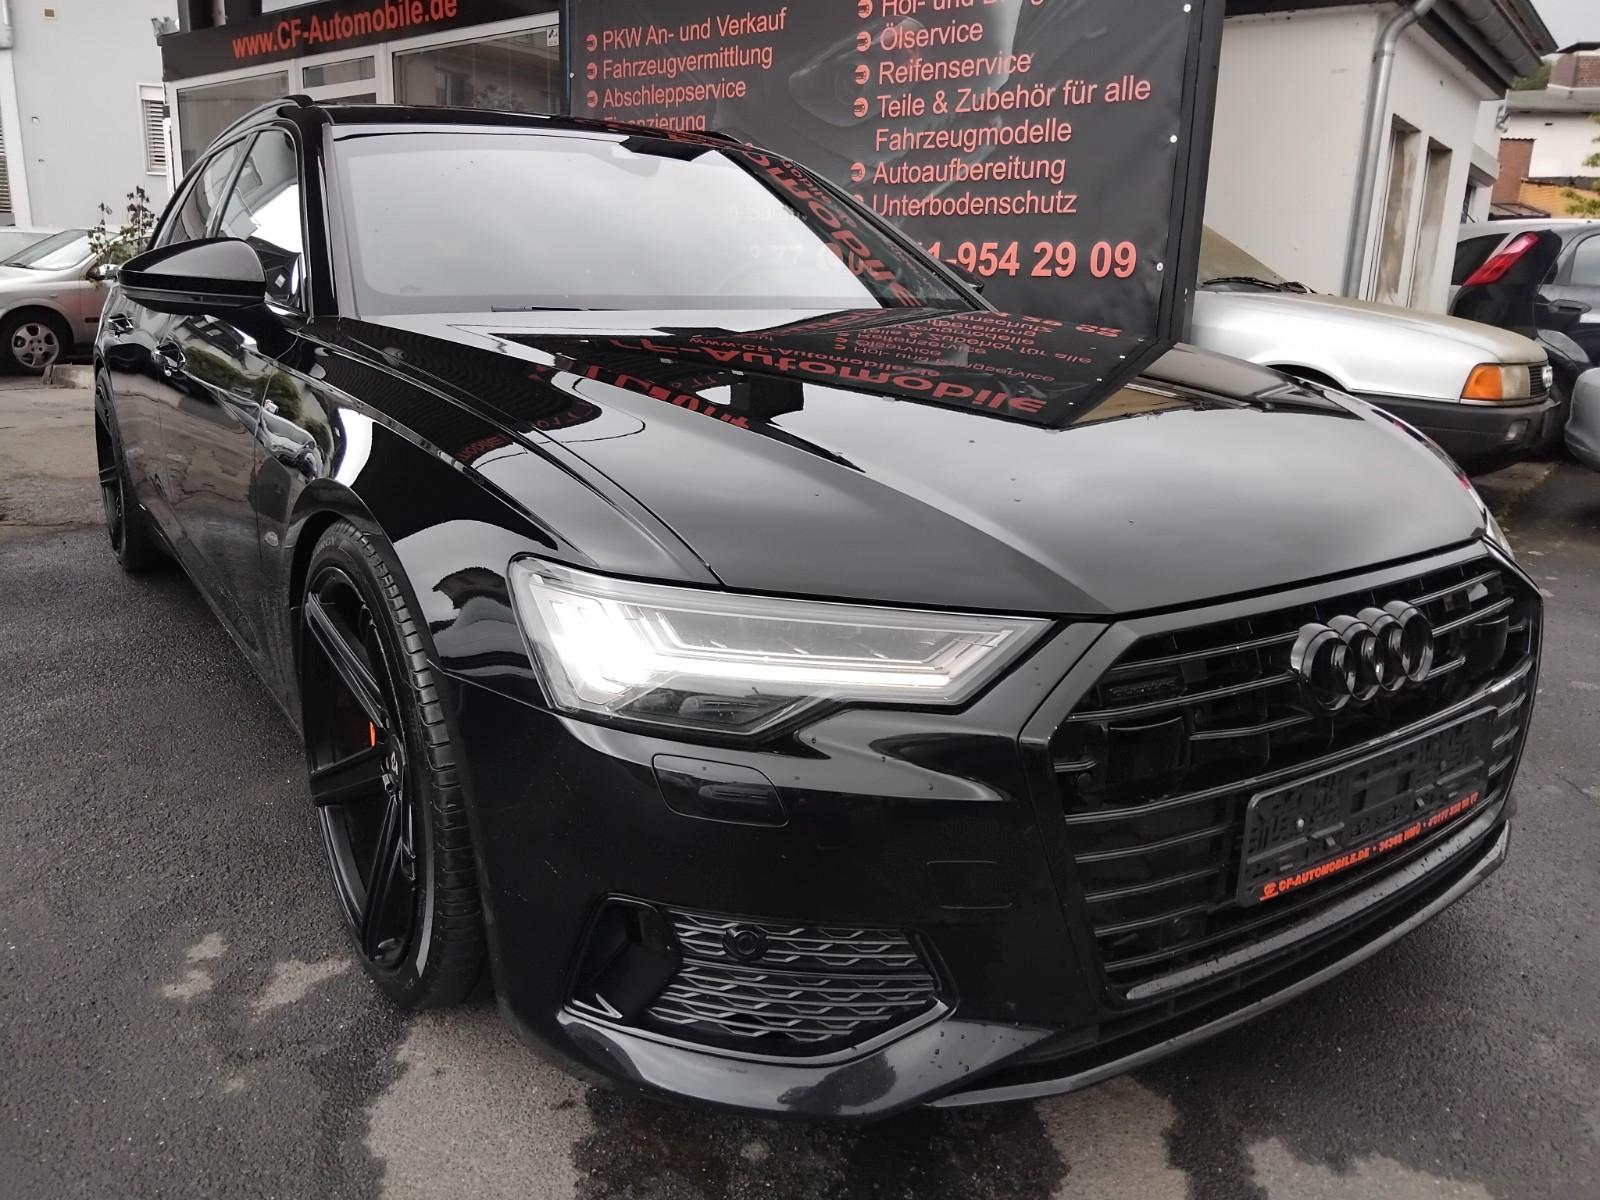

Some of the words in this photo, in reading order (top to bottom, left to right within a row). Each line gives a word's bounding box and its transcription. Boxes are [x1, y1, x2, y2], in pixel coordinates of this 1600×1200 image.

[232, 0, 457, 59] www.CF-Automobile.de
[603, 28, 641, 50] PKW
[646, 25, 674, 46] An-
[680, 20, 711, 42] und
[716, 7, 787, 37] Verkauf
[880, 20, 983, 51] Ölservice
[603, 45, 773, 80] Fahrzeugvermittlung
[878, 52, 1031, 85] Reifenservice
[603, 77, 746, 109] Abschleppservice
[877, 91, 924, 119] Teile
[933, 90, 948, 114] &
[955, 84, 1055, 113] Zubehör
[1063, 79, 1097, 105] für
[1105, 75, 1151, 102] alle
[875, 118, 1072, 153] Fahrzeugmodelle
[872, 156, 1066, 185] Autoaufbereitung
[872, 191, 1078, 218] Unterbodenschutz
[1031, 241, 1077, 278] 29
[1089, 240, 1138, 279] 09
